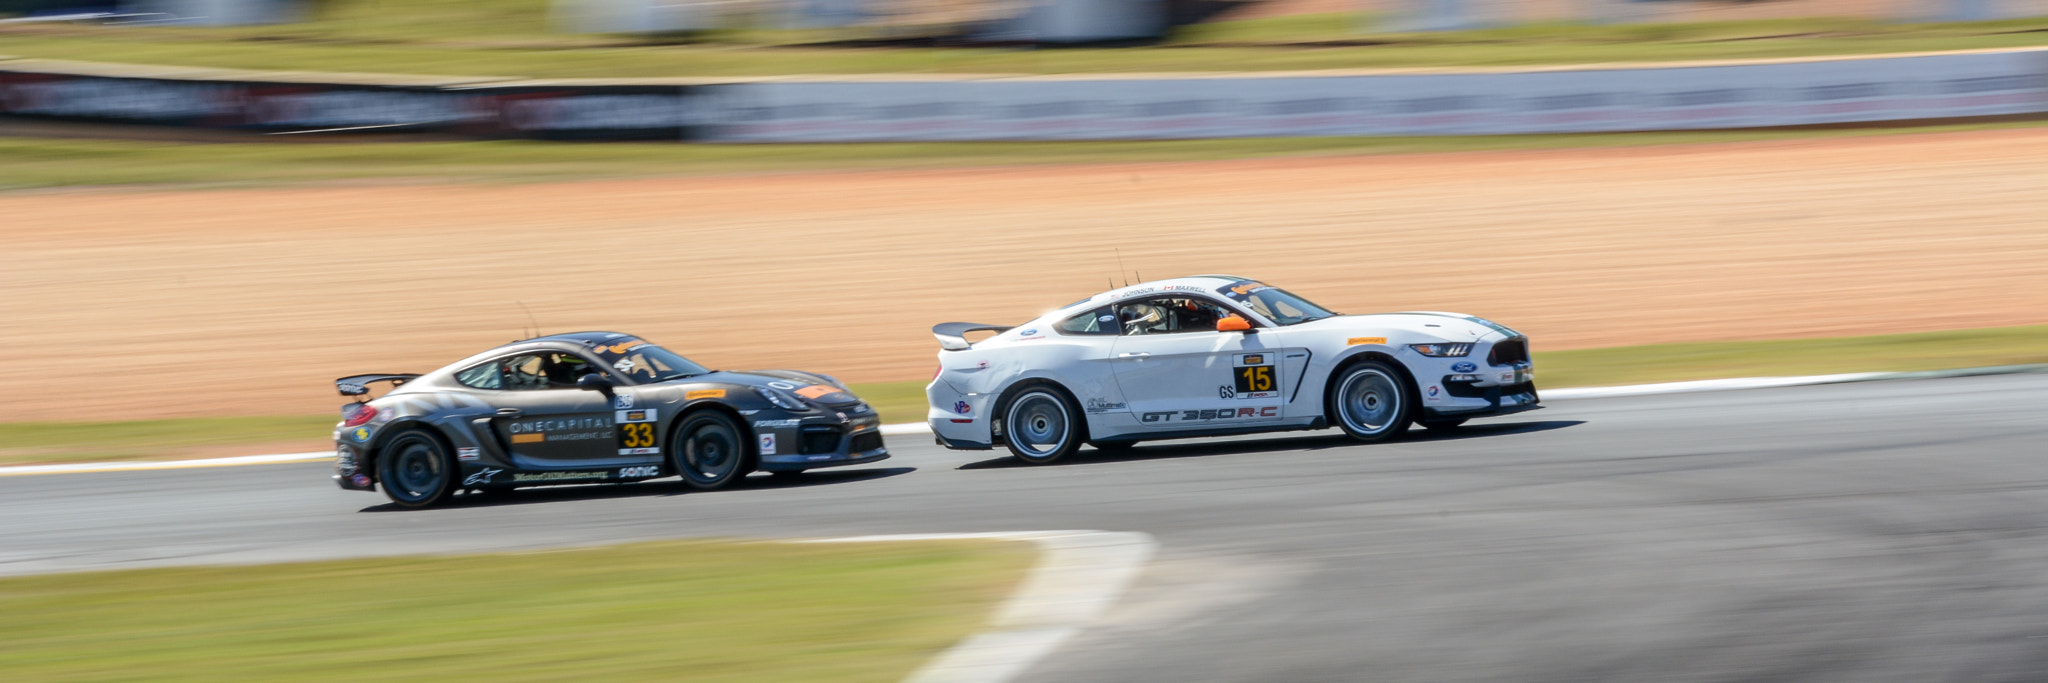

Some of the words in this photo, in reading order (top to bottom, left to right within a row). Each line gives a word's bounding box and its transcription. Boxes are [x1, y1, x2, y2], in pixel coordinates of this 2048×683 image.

[1121, 286, 1155, 298] JOHNSON
[1174, 285, 1207, 293] MAXWELL
[1243, 366, 1271, 391] 15
[1219, 386, 1234, 398] GS
[1141, 411, 1178, 423] GT
[623, 423, 654, 448] 33
